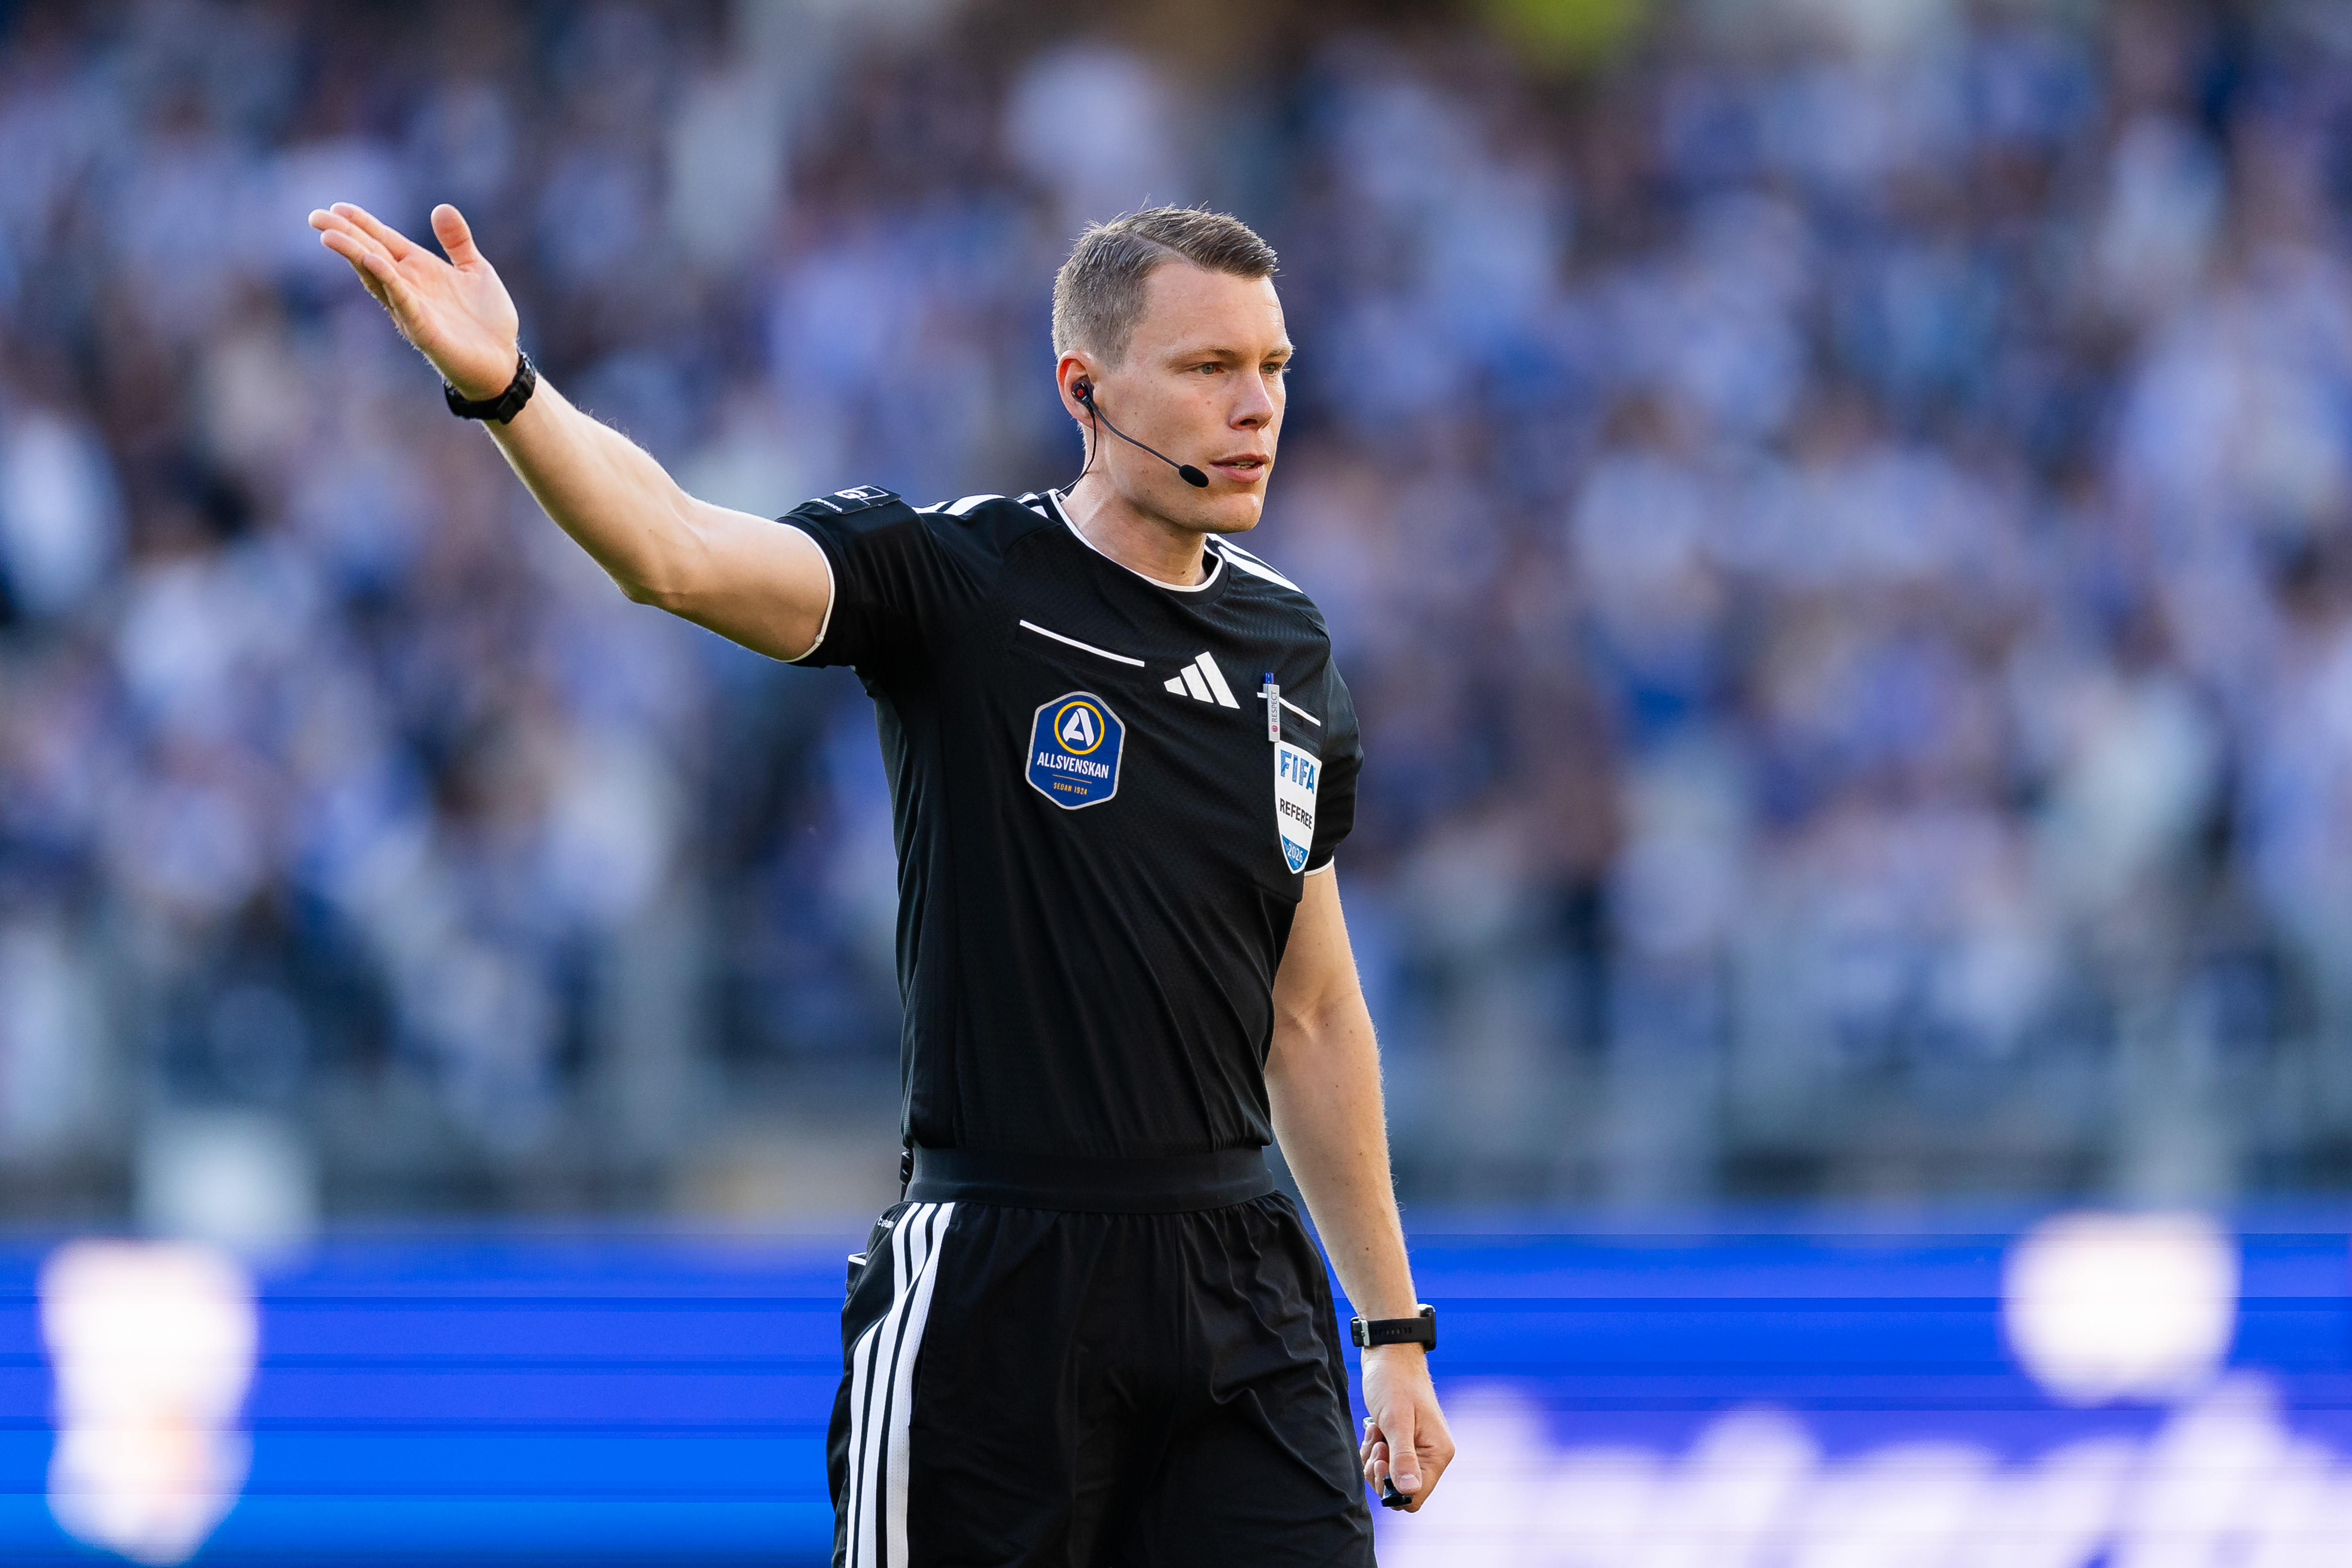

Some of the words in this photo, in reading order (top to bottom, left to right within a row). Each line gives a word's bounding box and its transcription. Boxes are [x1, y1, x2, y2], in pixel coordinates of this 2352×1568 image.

[1037, 752, 1109, 778] ALLSVENSKAN
[1280, 749, 1314, 795] FIFA
[1054, 782, 1072, 792] SEDAN
[1074, 786, 1087, 795] 1924
[1280, 798, 1312, 830] REFEREE
[1287, 843, 1303, 863] 2026
